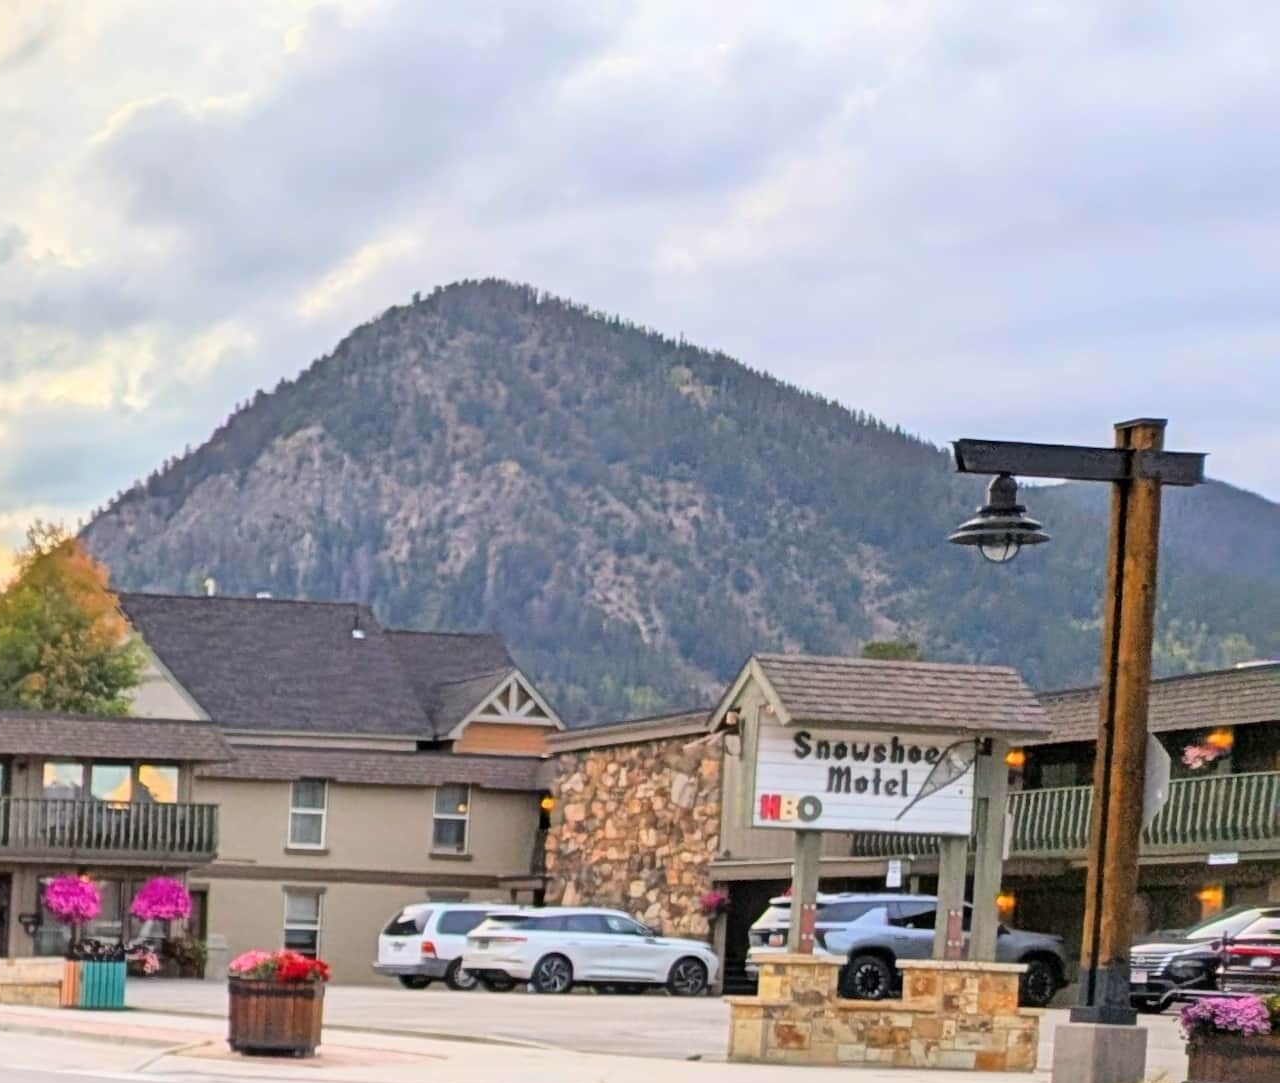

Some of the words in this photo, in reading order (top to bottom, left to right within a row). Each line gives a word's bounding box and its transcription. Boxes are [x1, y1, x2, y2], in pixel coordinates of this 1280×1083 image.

[793, 731, 940, 765] Snowshoe
[826, 766, 909, 797] Motel
[760, 794, 823, 822] HBO
